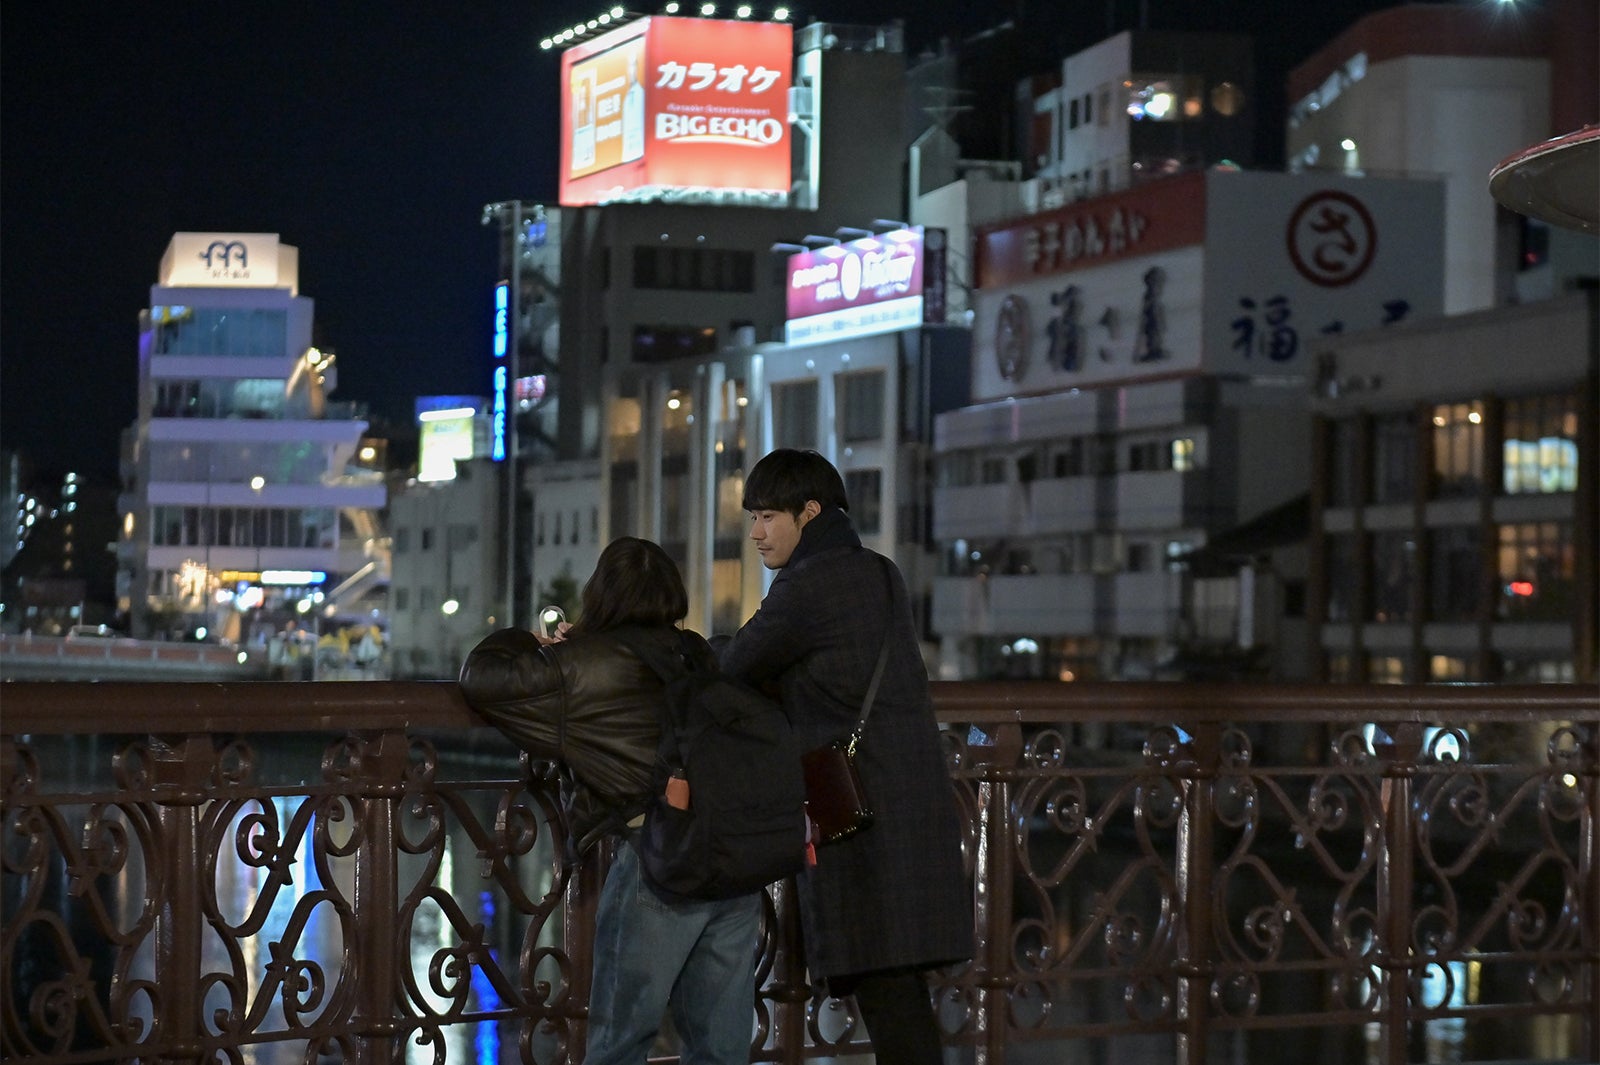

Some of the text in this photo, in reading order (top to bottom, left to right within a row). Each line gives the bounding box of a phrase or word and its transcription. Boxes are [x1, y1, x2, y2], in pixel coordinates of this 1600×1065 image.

[655, 61, 782, 94] カラオケ
[655, 112, 707, 139] BIG
[708, 116, 783, 145] ECHO
